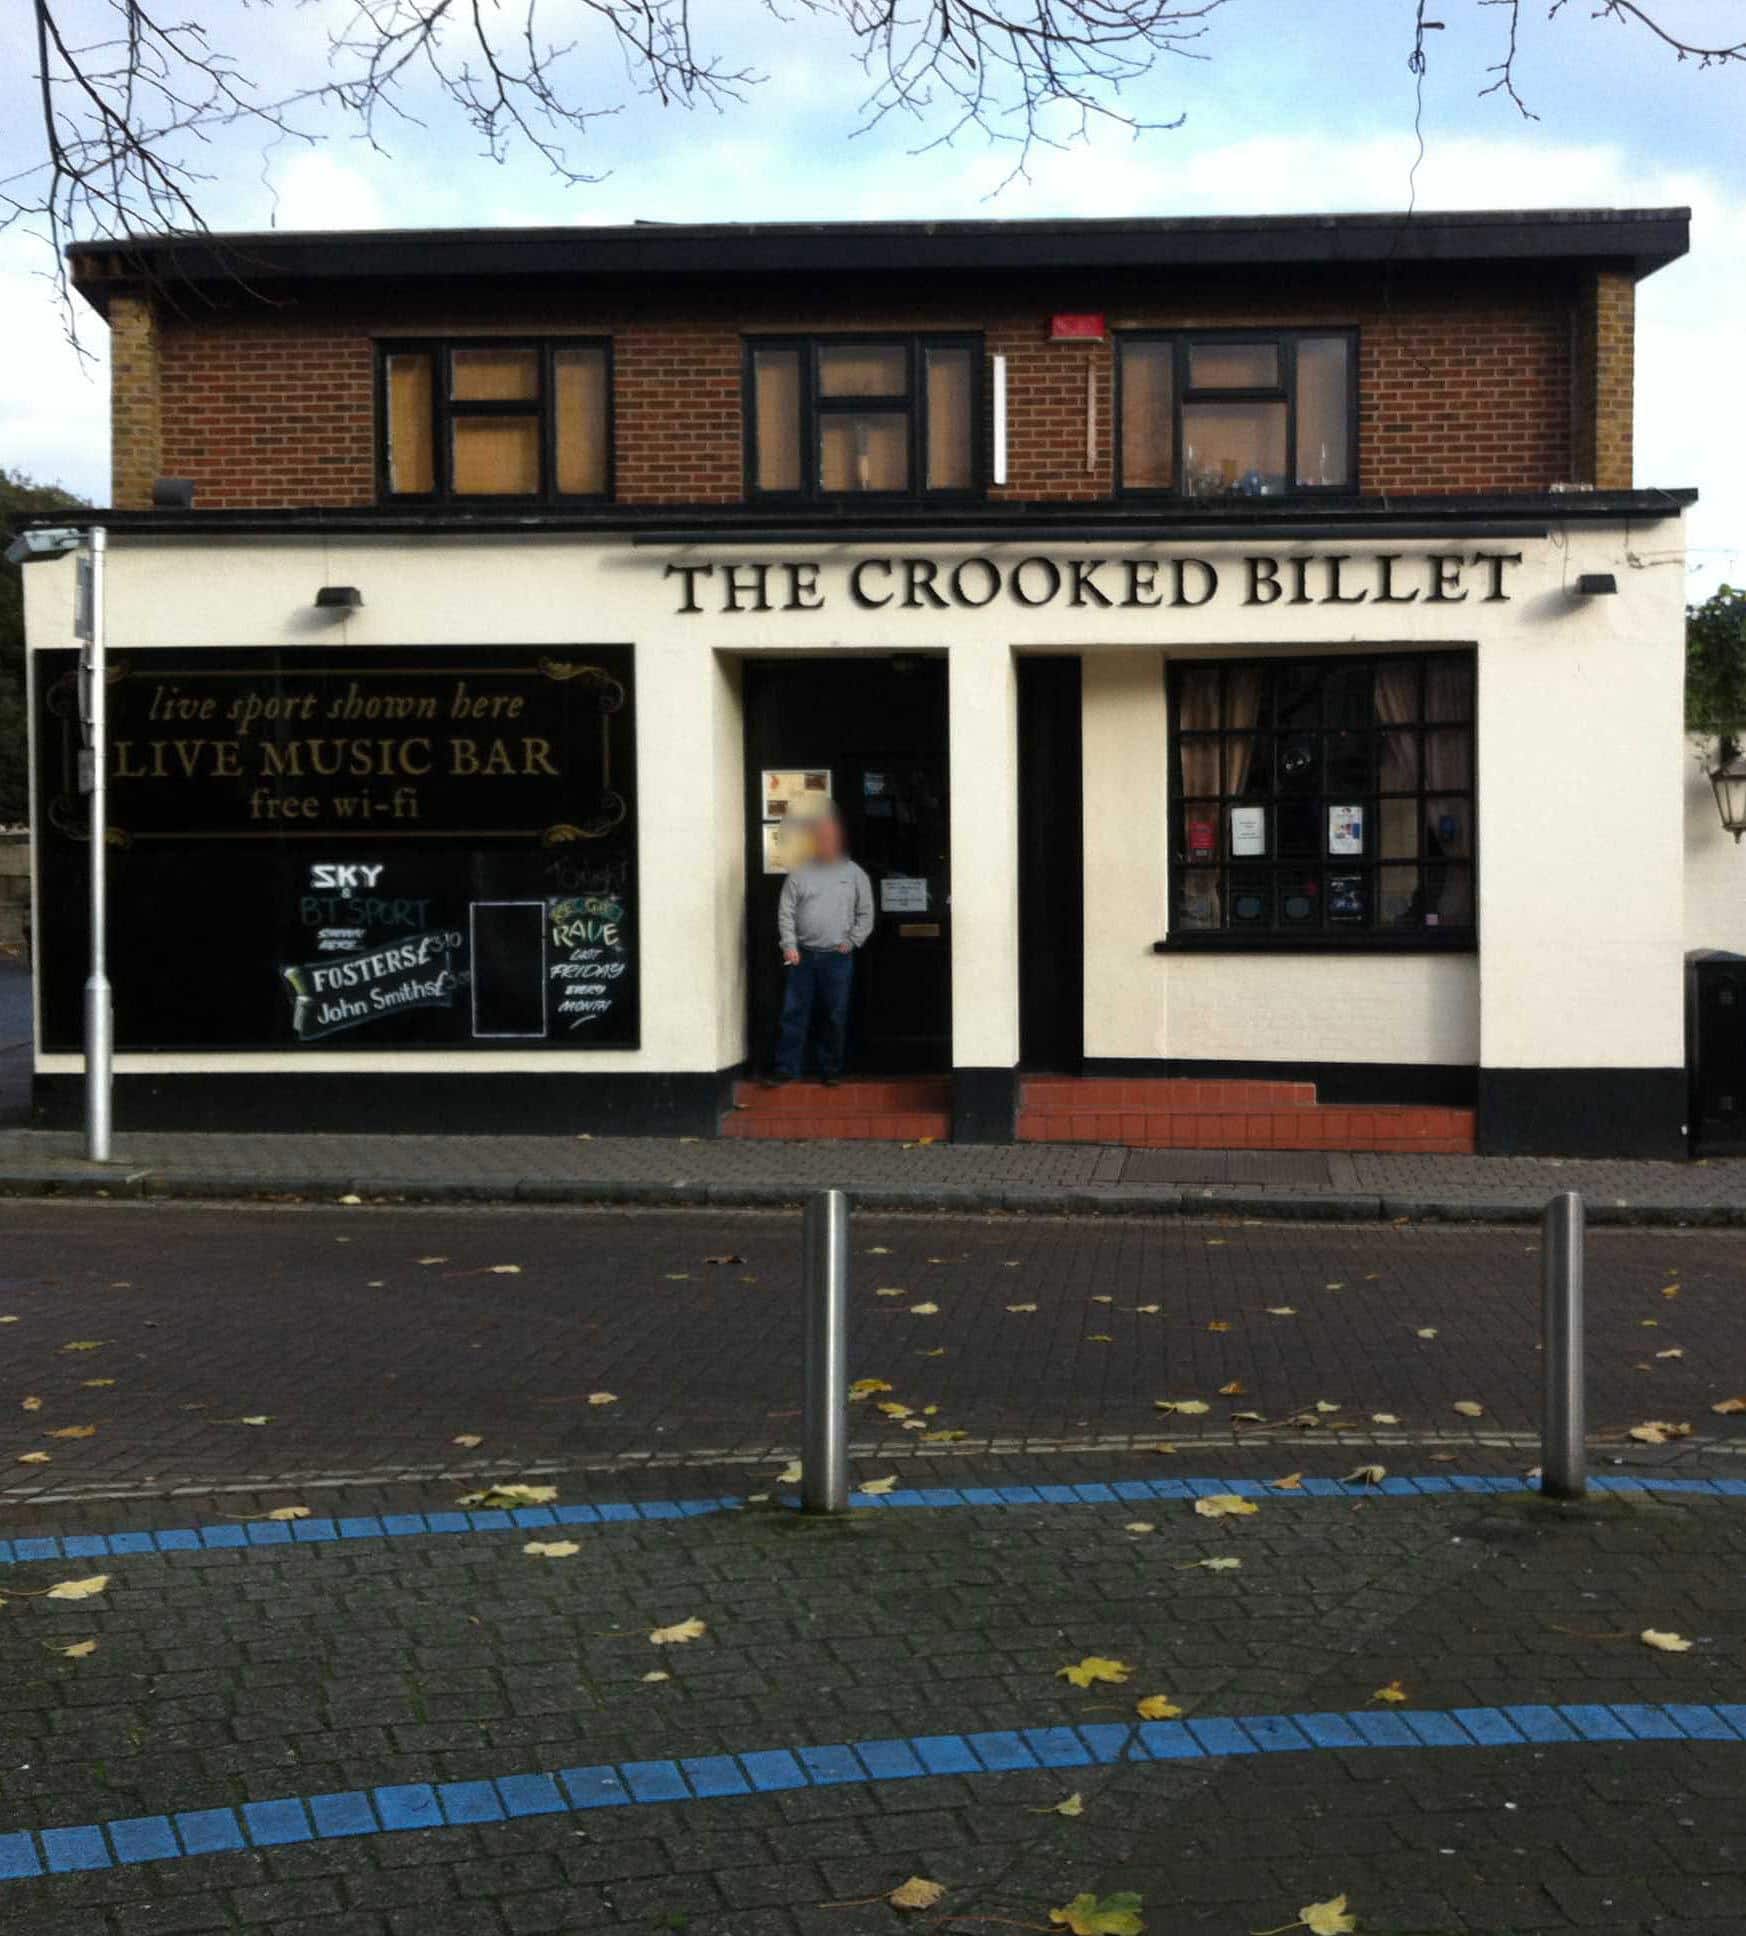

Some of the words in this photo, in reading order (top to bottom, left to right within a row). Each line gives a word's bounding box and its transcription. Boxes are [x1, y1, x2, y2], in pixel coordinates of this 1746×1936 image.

[664, 563, 826, 614] THE
[850, 555, 1219, 610] CROOKED
[1241, 551, 1523, 607] BILLET
[147, 684, 216, 720] live
[225, 690, 319, 737] sport
[326, 686, 438, 721] shown
[450, 682, 528, 720] here
[112, 740, 245, 778] LIVE
[260, 738, 434, 777] MUSIC
[448, 737, 562, 777] BAR
[248, 787, 321, 820] free
[332, 785, 423, 820] wi-fi
[310, 863, 384, 889] SKY
[300, 896, 340, 926] BT
[350, 896, 432, 928] SPORT
[552, 919, 621, 948] RAVE
[312, 944, 418, 993] FOSTERS
[549, 962, 627, 980] FRIDAY
[316, 996, 369, 1025] John
[369, 978, 435, 1012] Smiths
